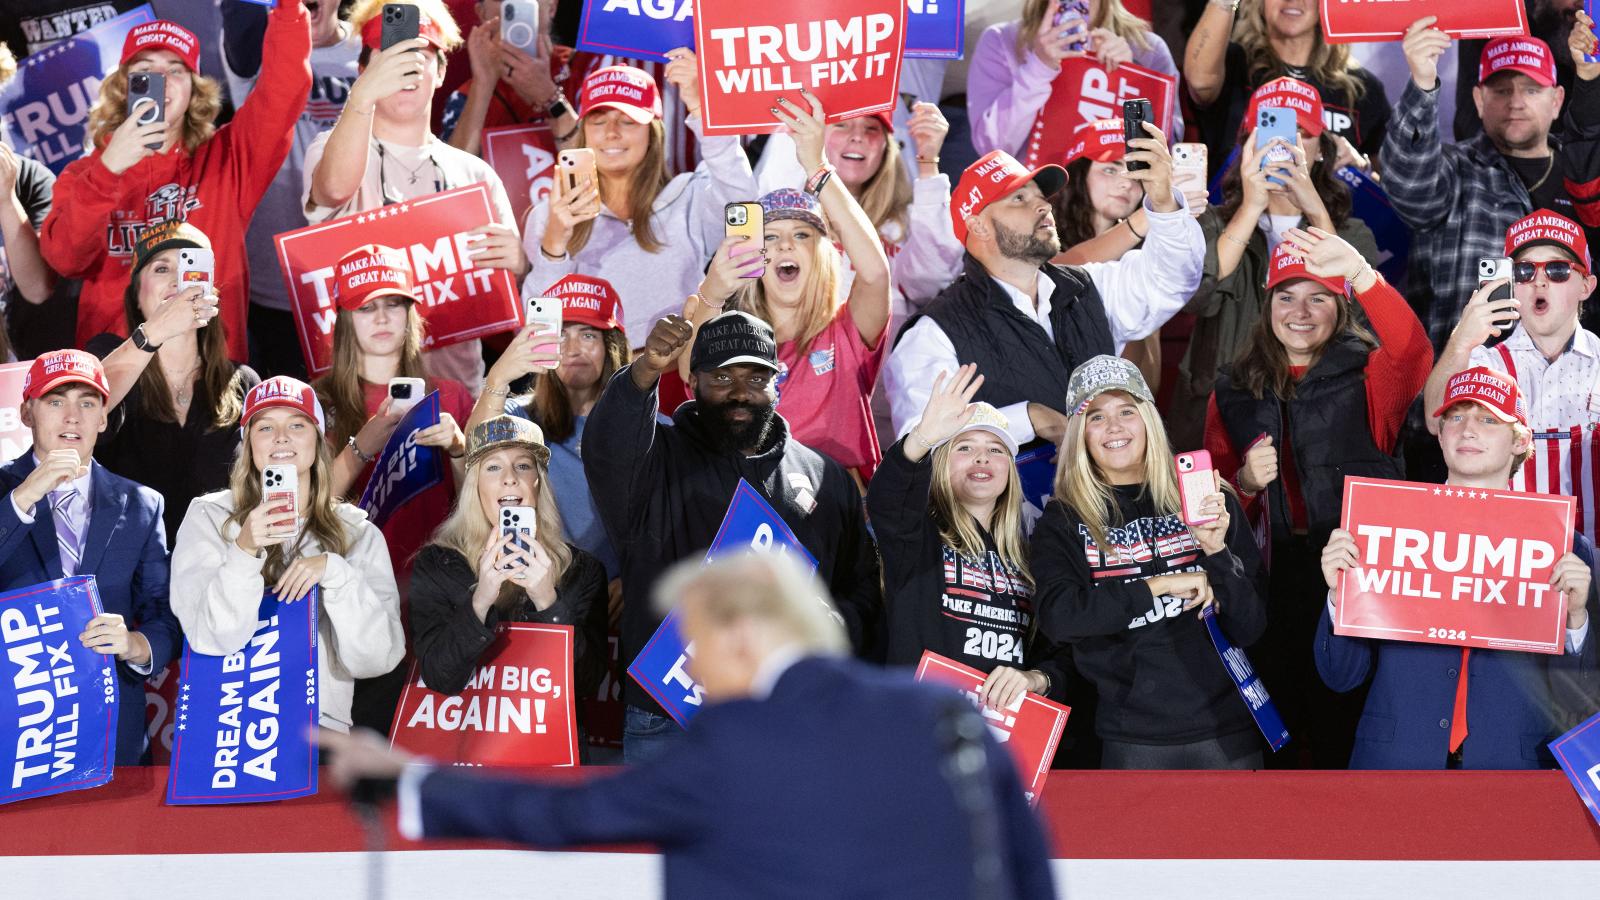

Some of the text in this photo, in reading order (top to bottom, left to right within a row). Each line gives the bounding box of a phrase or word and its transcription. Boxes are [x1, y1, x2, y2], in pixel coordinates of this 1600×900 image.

[133, 23, 195, 48] MAKE AMERICA
[136, 34, 191, 54] GREAT AGAIN
[711, 13, 895, 67] TRUMP
[1488, 42, 1545, 59] MAKE AMERICA
[715, 52, 892, 94] WILL FIX IT
[1491, 55, 1542, 70] GREAT AGAIN
[608, 71, 648, 90] AMECA
[1278, 80, 1317, 101] AMERICA
[1285, 97, 1312, 114] AGAIN
[24, 132, 82, 166] ILL
[1100, 133, 1125, 146] GREA
[975, 157, 1002, 178] MAK
[991, 166, 1011, 184] GRE
[1337, 166, 1363, 188] 202
[959, 186, 984, 221] 45-47
[1510, 216, 1580, 237] MAKE AMERICA
[1514, 229, 1574, 247] GREAT AGAIN
[300, 232, 489, 308] TMP
[341, 257, 369, 276] MAKE
[348, 270, 379, 289] GREAT
[464, 267, 495, 297] IT
[562, 281, 608, 299] AMERICA
[569, 297, 602, 311] AGAIN
[702, 324, 730, 341] MAKE
[708, 338, 769, 355] GREAT AGAIN
[43, 354, 64, 367] MAKE
[46, 361, 70, 375] GREAT
[254, 380, 304, 402] MAGA
[1449, 373, 1512, 396] MAKE AMERICA
[1450, 384, 1506, 405] GREAT AGAIN
[1079, 513, 1205, 568] TRUM
[1357, 524, 1556, 579] TRUMP
[1355, 567, 1551, 608] WILL FIX IT
[1427, 627, 1467, 641] 2024
[963, 627, 1024, 665] 2024
[35, 603, 79, 780] WILL FIX IT
[104, 666, 115, 704] 2024
[306, 668, 315, 705] 2024
[501, 665, 561, 699] BIG,
[1, 608, 55, 789] TRUMP
[243, 614, 280, 782] AGAIN!
[406, 693, 547, 734] AGAIN!
[211, 681, 244, 789] DREAM
